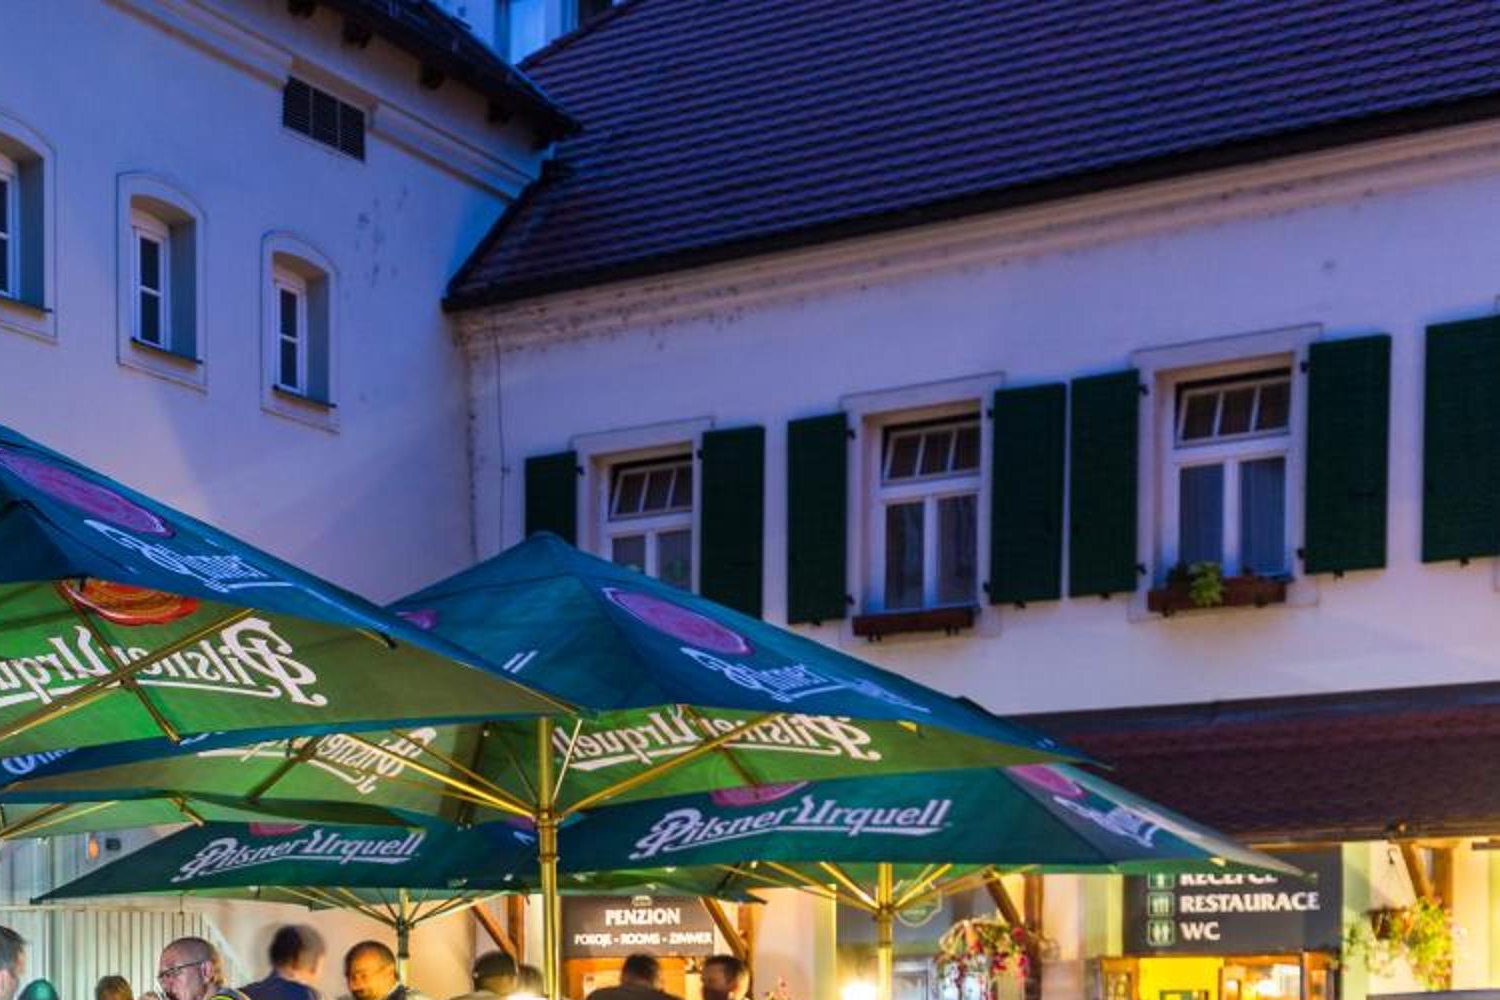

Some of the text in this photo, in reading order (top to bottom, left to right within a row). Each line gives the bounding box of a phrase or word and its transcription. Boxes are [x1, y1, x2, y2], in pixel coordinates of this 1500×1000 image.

[629, 795, 953, 861] Pilsner Urquell
[171, 828, 428, 883] Pilsner Urquell
[1179, 891, 1321, 914] RESTAURACE
[604, 907, 681, 927] PENZION
[1180, 921, 1221, 941] WC
